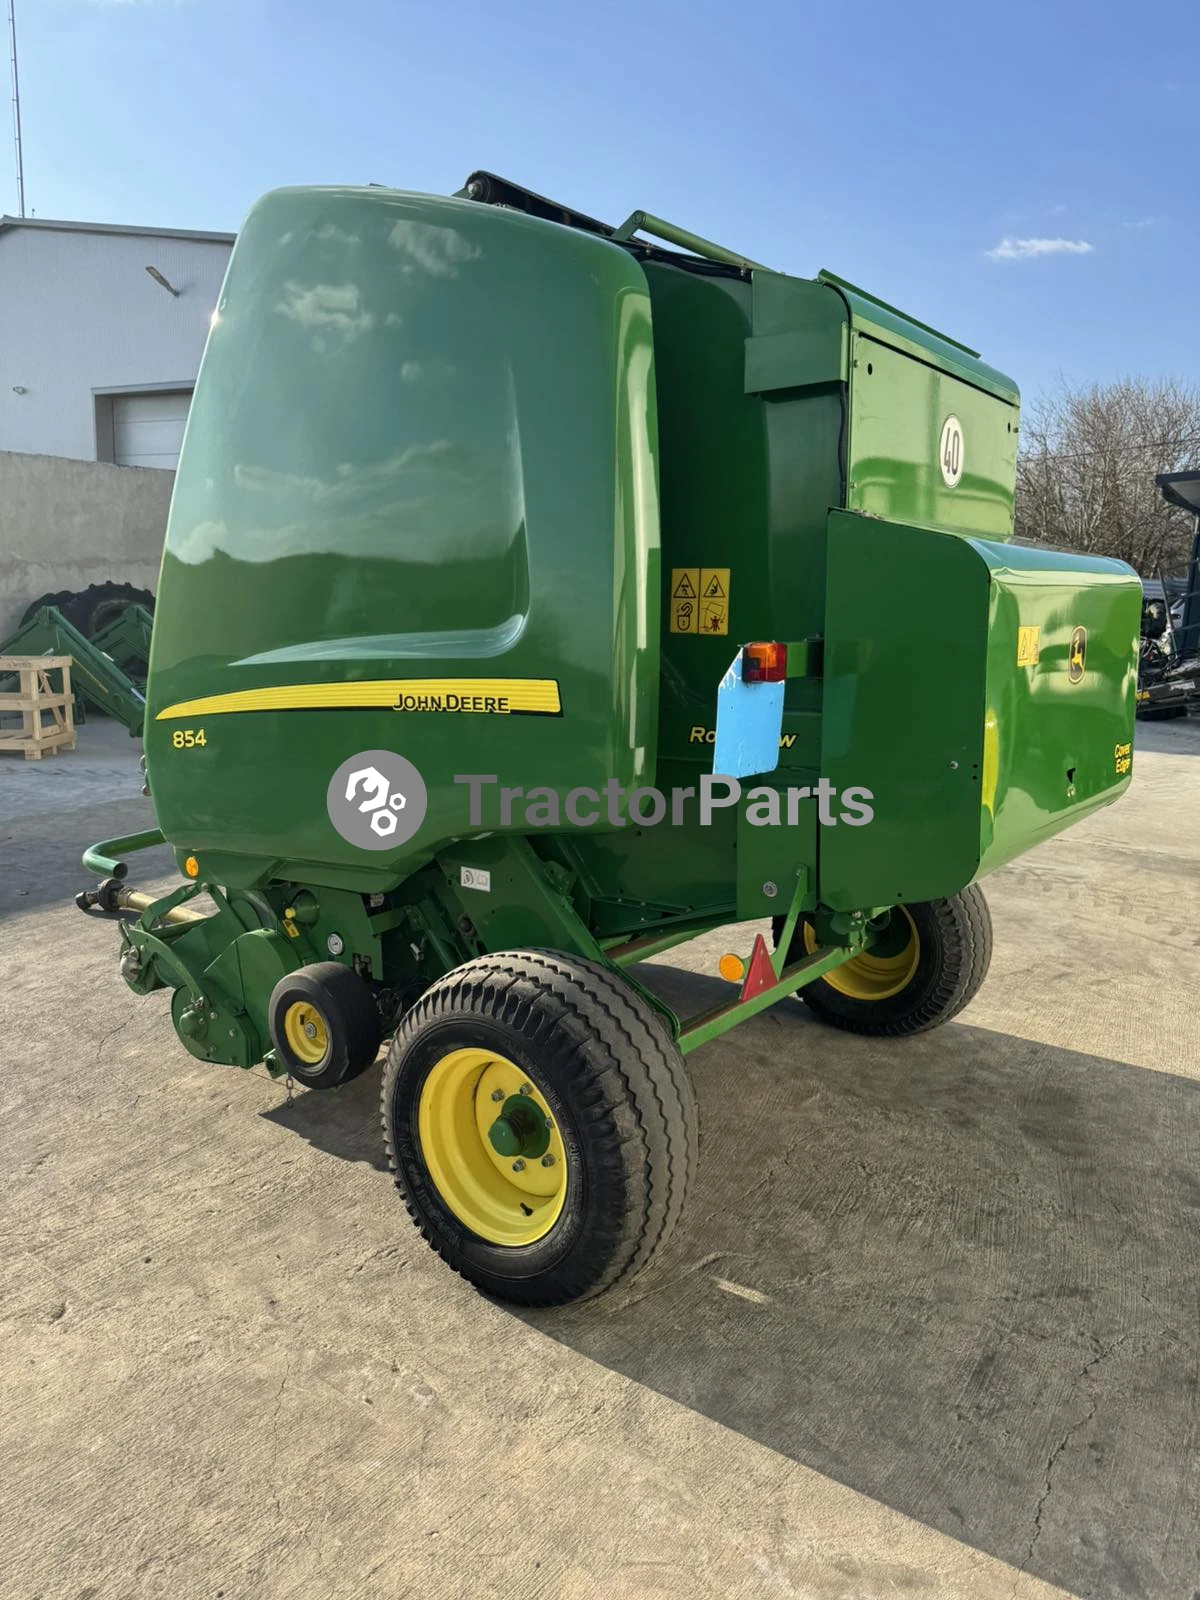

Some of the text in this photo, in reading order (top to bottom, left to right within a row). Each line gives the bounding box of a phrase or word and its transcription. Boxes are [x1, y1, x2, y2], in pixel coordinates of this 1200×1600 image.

[943, 427, 960, 476] 40
[393, 693, 510, 713] JOHN DEERE
[172, 728, 208, 749] 854
[1114, 742, 1131, 758] Cover
[1115, 758, 1131, 774] Edge
